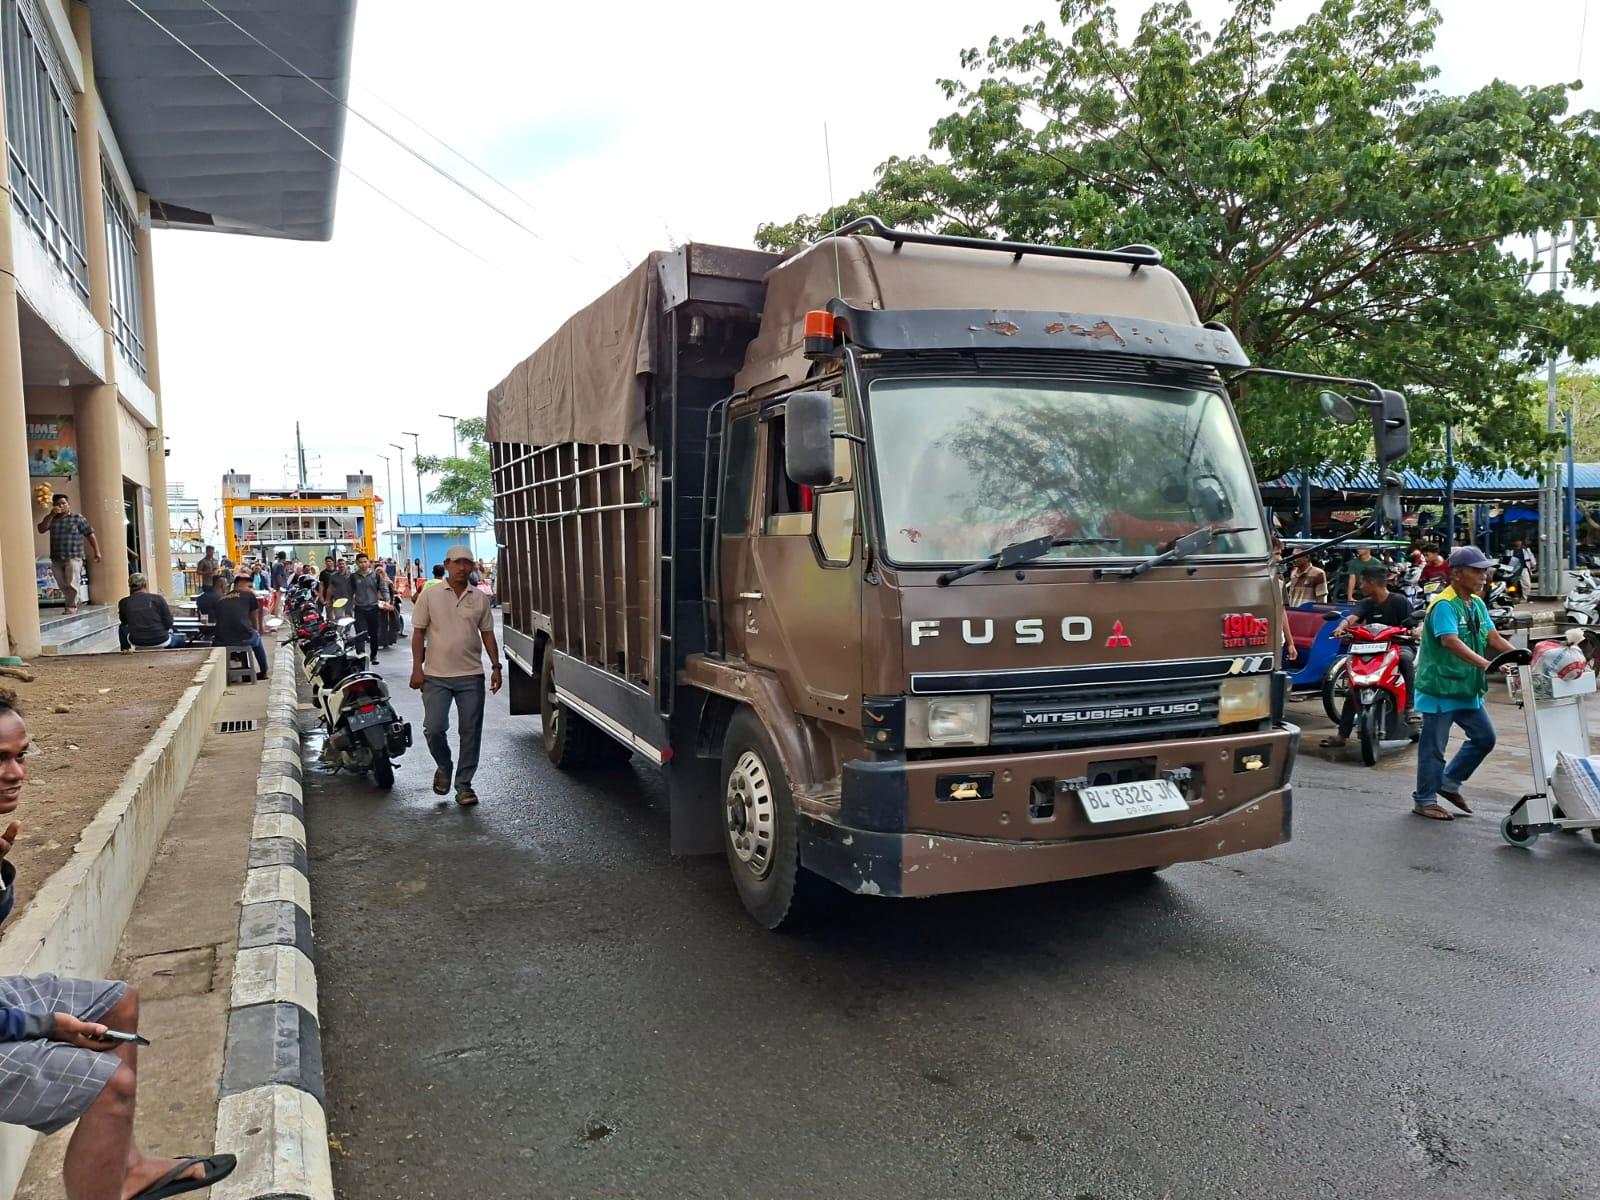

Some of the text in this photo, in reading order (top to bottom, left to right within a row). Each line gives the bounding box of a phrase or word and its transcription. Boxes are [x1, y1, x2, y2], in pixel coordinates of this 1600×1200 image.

[911, 616, 1092, 646] FUSO
[1025, 703, 1199, 724] MITSUBISHI FUSO
[1086, 782, 1178, 809] BL 8326 JK
